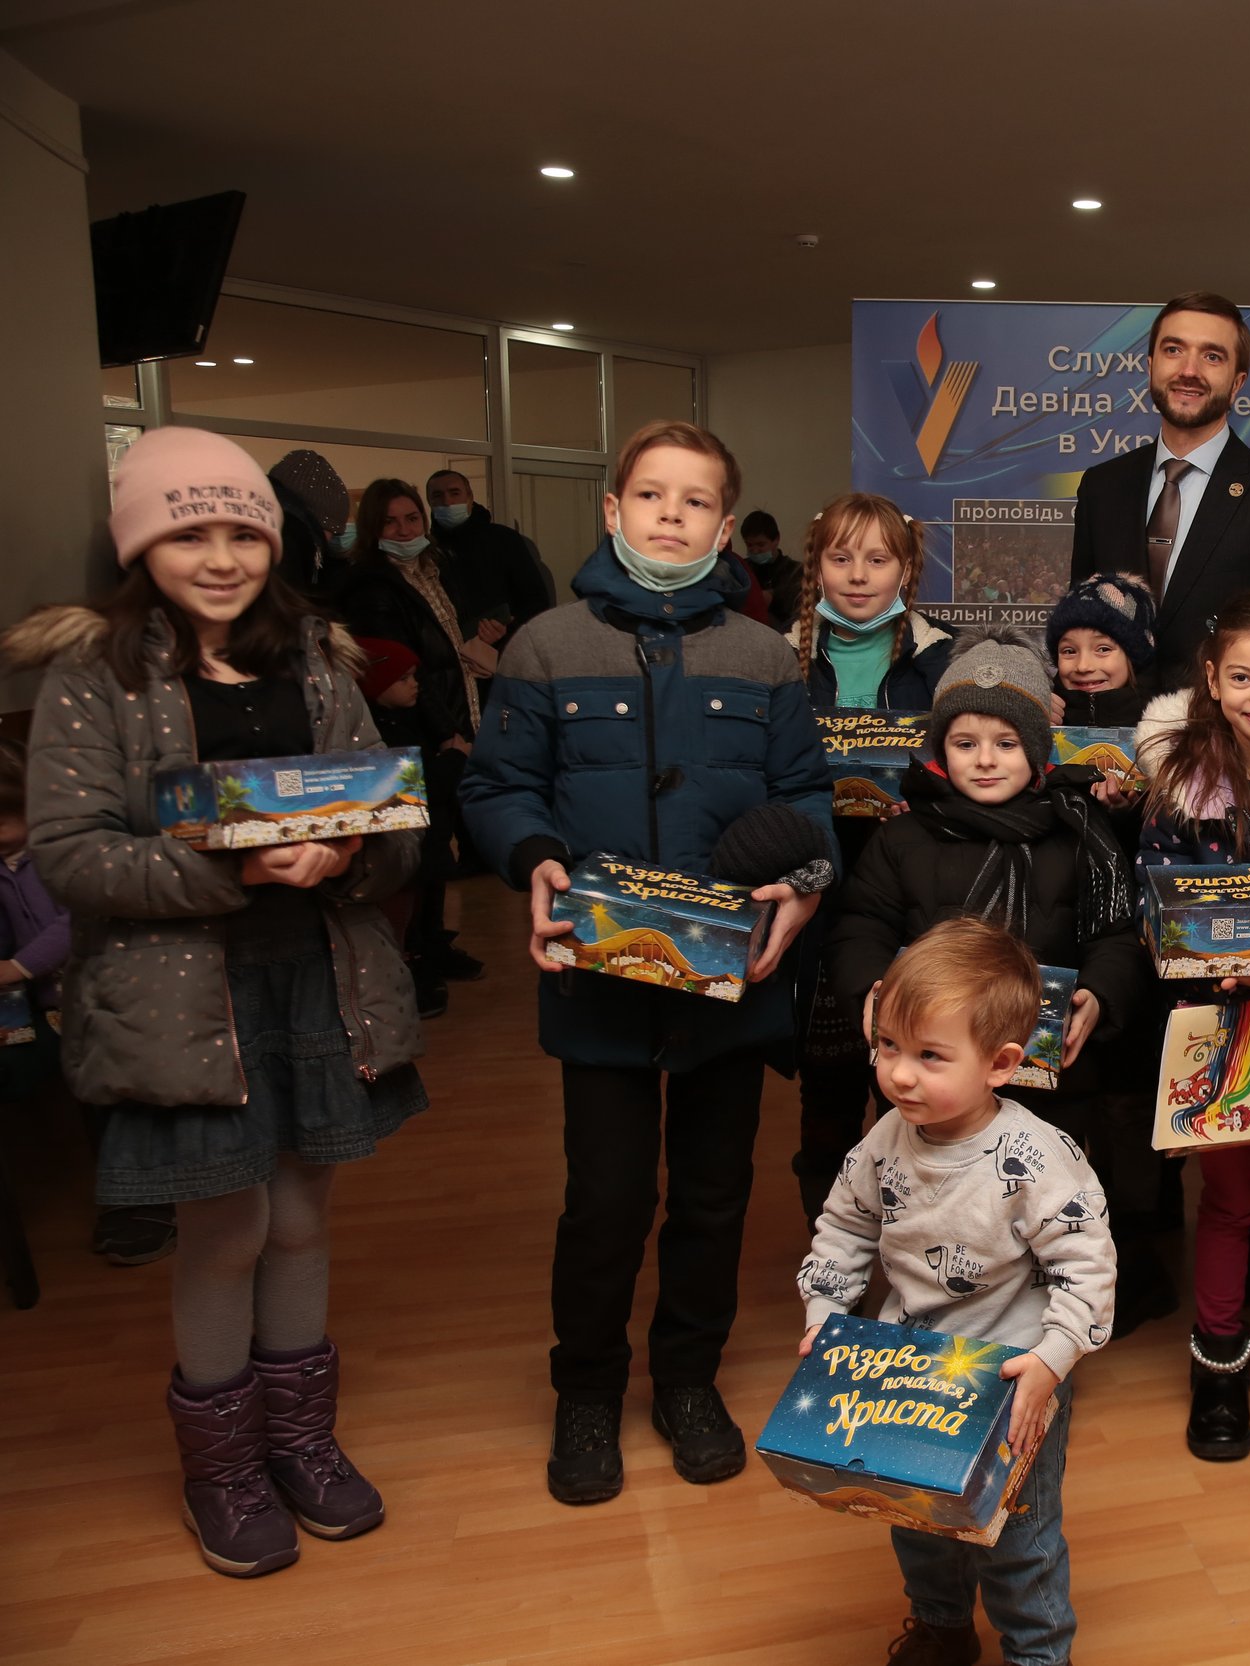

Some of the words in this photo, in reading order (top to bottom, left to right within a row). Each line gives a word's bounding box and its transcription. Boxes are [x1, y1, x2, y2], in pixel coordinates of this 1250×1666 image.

[1048, 346, 1145, 377] Служ
[991, 386, 1113, 417] Девіда
[165, 489, 182, 504] NO
[188, 486, 243, 499] PICTURES
[960, 504, 1064, 522] проповідь
[1000, 610, 1050, 627] хрис
[822, 735, 925, 756] Христа
[601, 862, 699, 886] Різдво
[617, 881, 743, 911] Христа
[1019, 1131, 1032, 1142] BE
[1009, 1146, 1024, 1158] FOR
[1013, 1139, 1045, 1160] READY
[955, 1244, 967, 1256] BE
[826, 1259, 838, 1270] BE
[951, 1264, 965, 1276] FOR
[952, 1255, 984, 1273] READY
[820, 1269, 849, 1286] READY
[823, 1344, 932, 1381] Різдво
[881, 1375, 966, 1399] почалося
[826, 1390, 969, 1447] Христа
